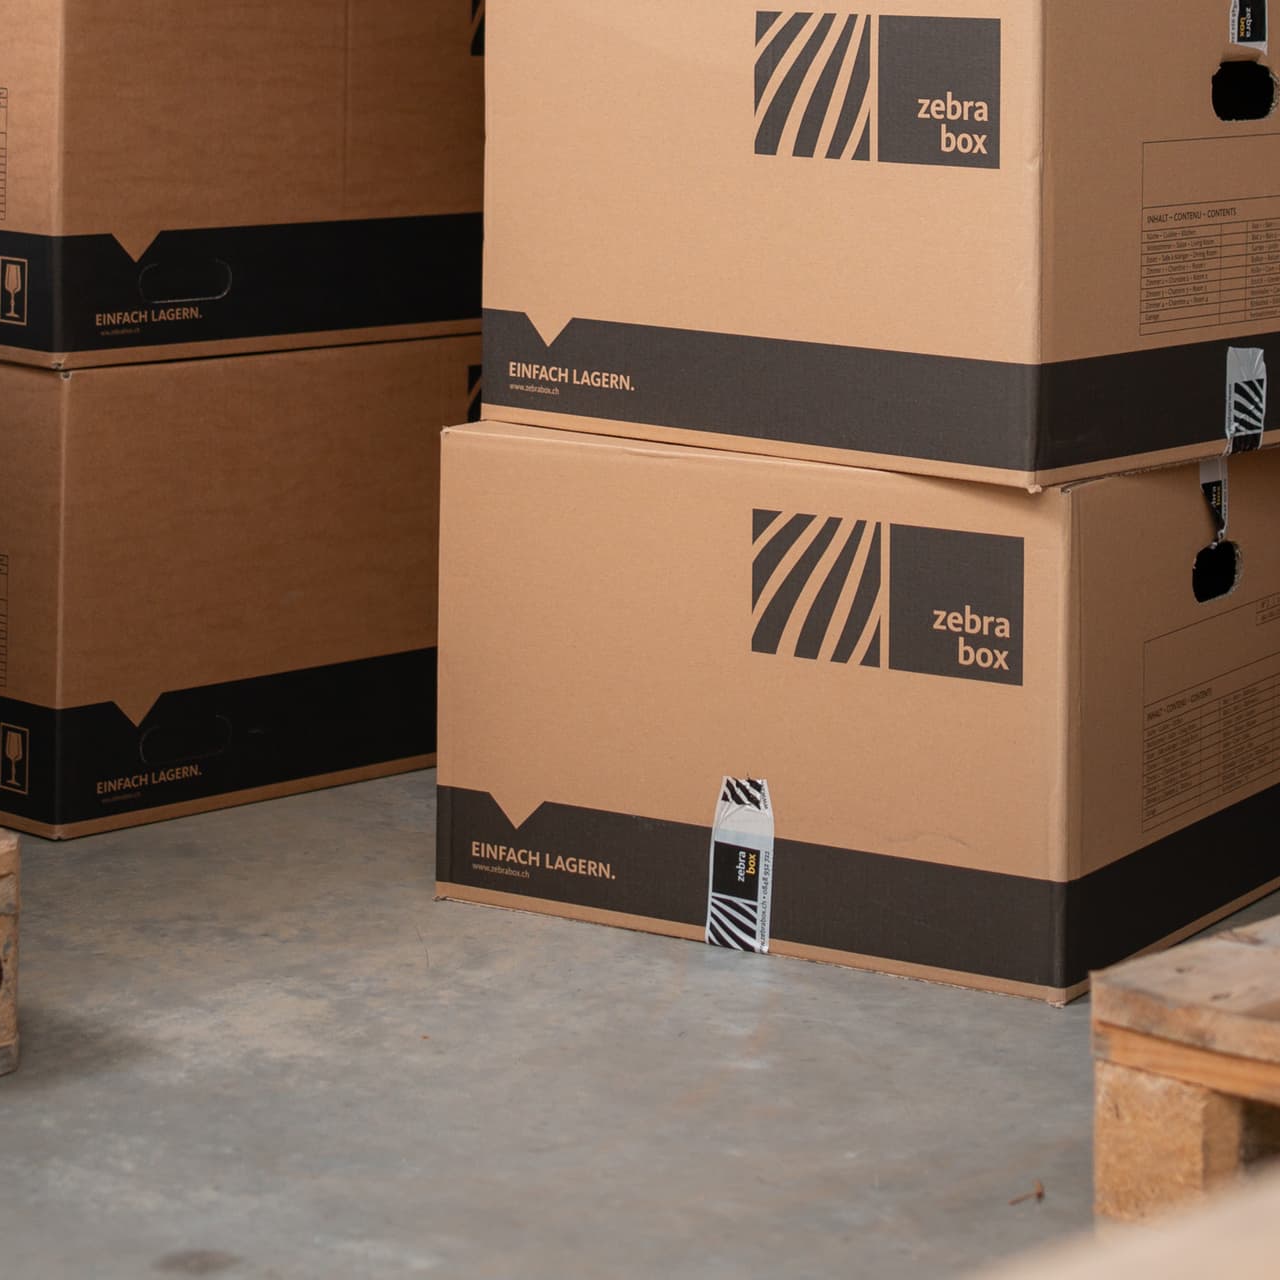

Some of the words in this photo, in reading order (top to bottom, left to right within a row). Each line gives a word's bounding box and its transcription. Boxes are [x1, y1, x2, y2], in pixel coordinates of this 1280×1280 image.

[1245, 6, 1253, 38] zebra
[917, 91, 989, 122] zebra
[940, 123, 988, 154] box
[95, 310, 148, 326] EINFACH
[151, 306, 203, 322] LAGERN.
[508, 361, 569, 384] EINFACH
[573, 368, 635, 392] LAGERN.
[933, 604, 1010, 638] zebra
[958, 636, 1010, 671] box
[96, 773, 148, 794] EINFACH
[151, 764, 202, 785] LAGERN.
[471, 840, 540, 867] EINFACH
[545, 853, 616, 880] LAGERN.
[737, 850, 747, 882] zebra
[746, 853, 757, 876] box
